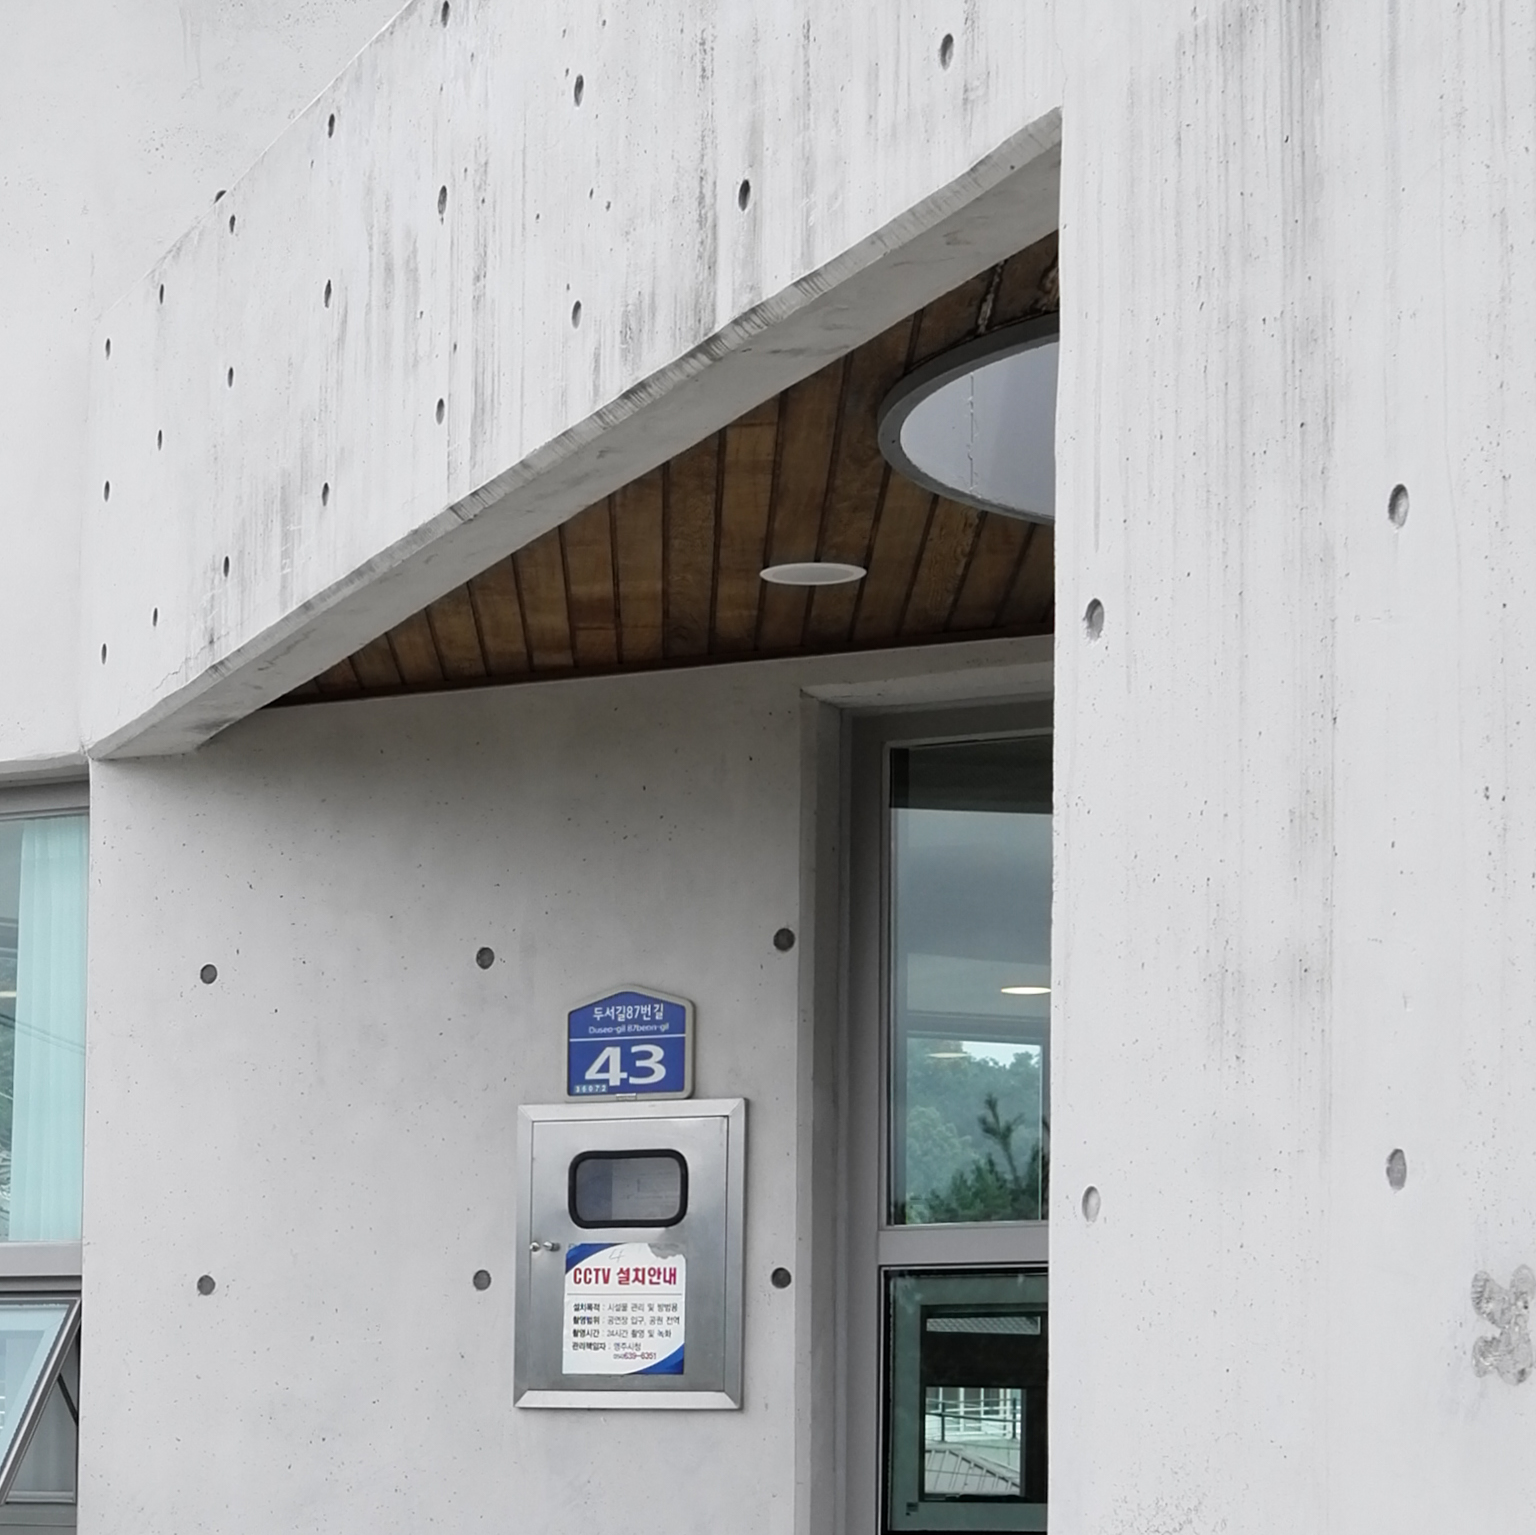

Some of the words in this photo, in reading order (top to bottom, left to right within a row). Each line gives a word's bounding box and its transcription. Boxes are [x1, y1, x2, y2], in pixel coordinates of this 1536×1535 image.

[588, 1023, 626, 1034] Duseo-gil
[585, 1044, 667, 1086] 43
[573, 1267, 611, 1285] CCTV
[616, 1267, 677, 1285] 설치안내
